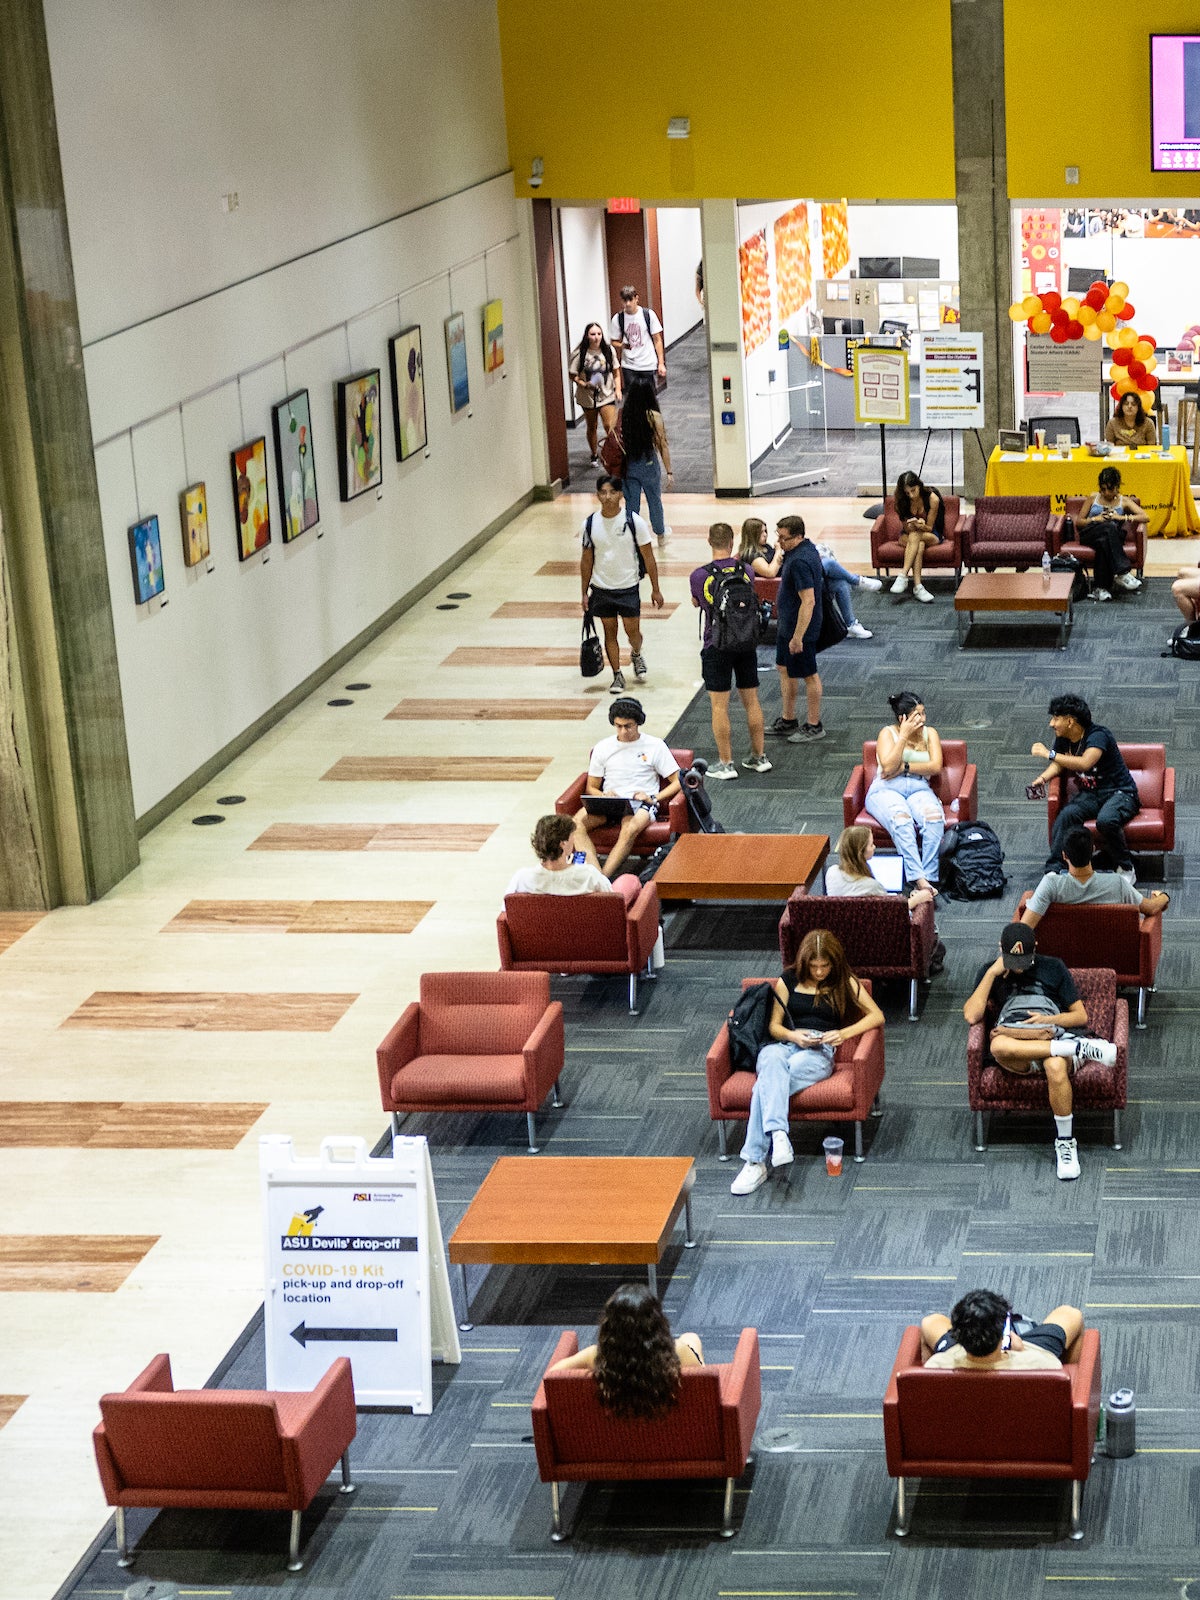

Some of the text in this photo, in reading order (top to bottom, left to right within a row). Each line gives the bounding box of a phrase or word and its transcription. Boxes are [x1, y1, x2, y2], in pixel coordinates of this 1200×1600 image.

[353, 1193, 371, 1202] ASU
[283, 1238, 401, 1250] ASU Devils' drop-off
[282, 1263, 384, 1276] COVID-19 Kit
[282, 1279, 404, 1291] pick-up and drop-off
[283, 1293, 331, 1303] location
